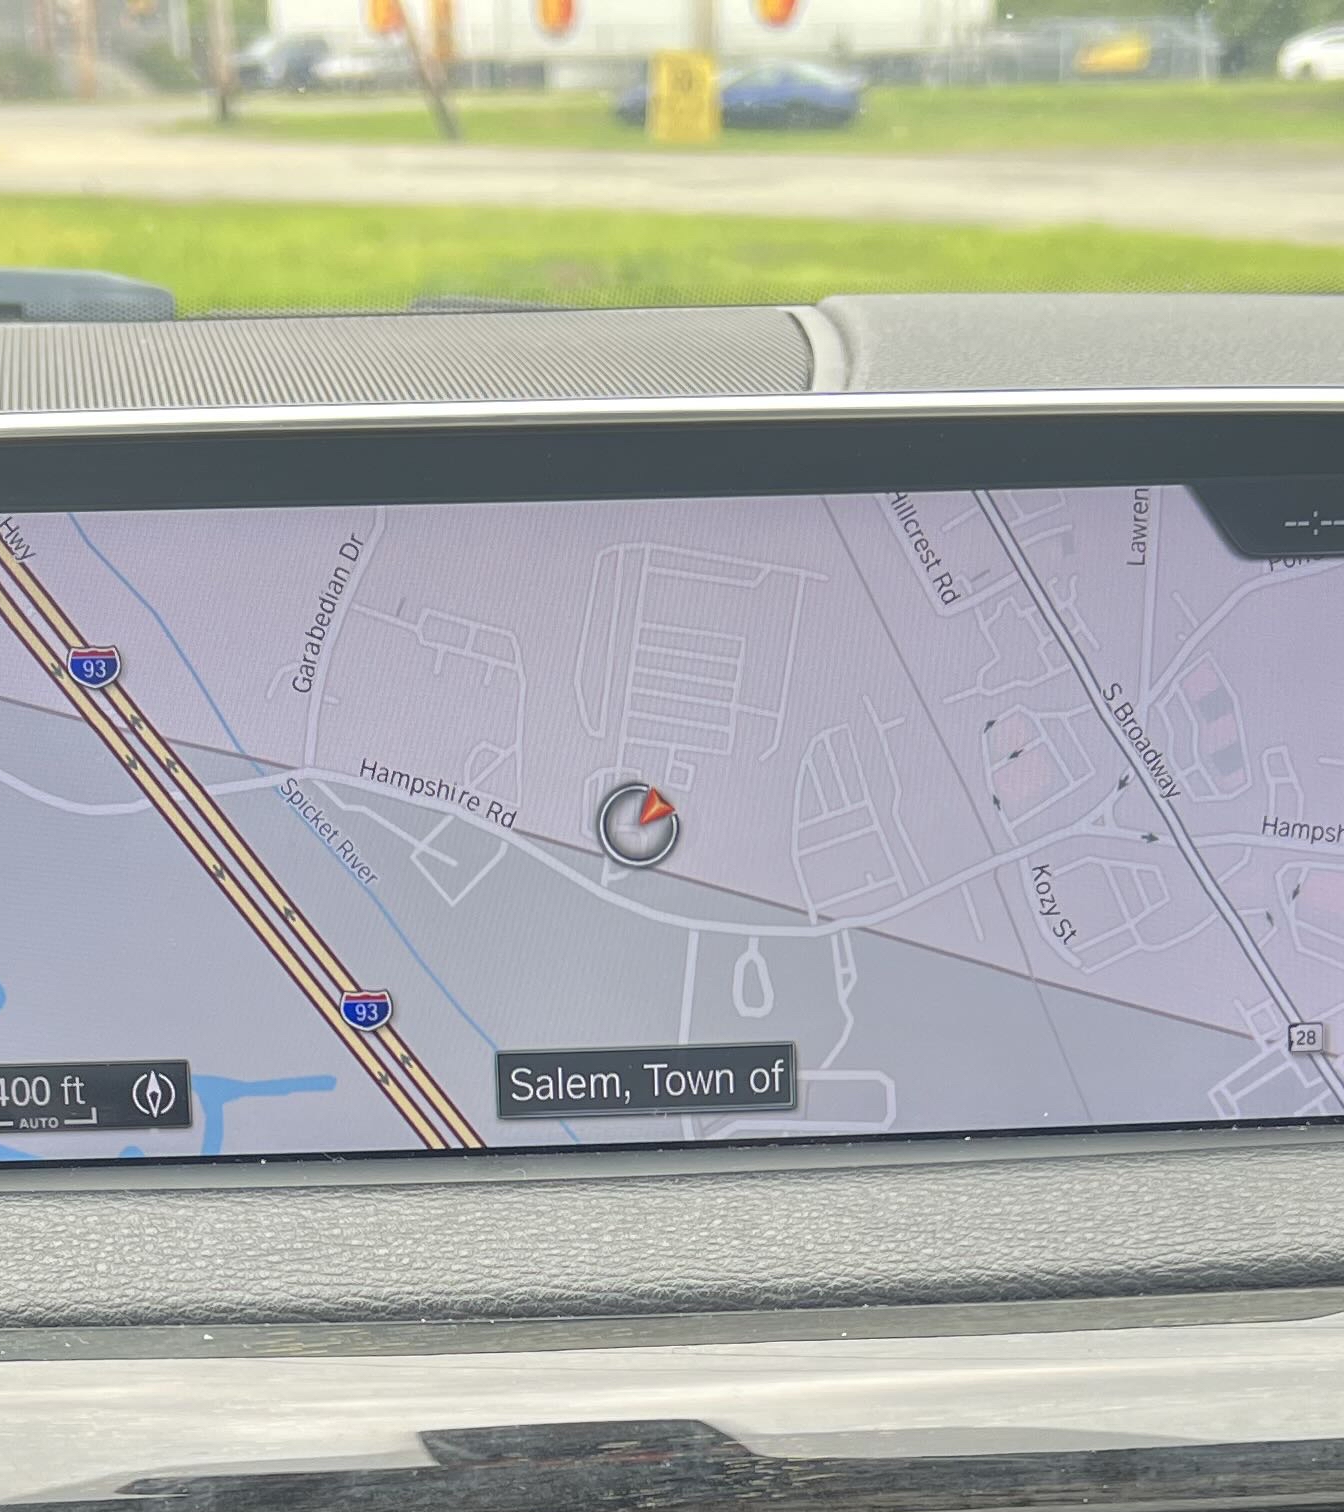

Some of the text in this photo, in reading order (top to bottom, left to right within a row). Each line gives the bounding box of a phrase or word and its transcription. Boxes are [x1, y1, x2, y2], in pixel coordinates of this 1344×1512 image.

[933, 572, 961, 605] Rd
[292, 533, 364, 692] Garabedian Dr
[83, 659, 107, 679] 93
[1102, 683, 1181, 799] S Broadway
[359, 758, 517, 828] Hampshire Rd
[280, 778, 379, 883] Spicket River
[1032, 864, 1076, 945] Kozy St
[355, 1004, 379, 1022] 93
[1296, 1030, 1316, 1045] 28
[61, 1075, 86, 1105] ft
[511, 1059, 785, 1104] Salem, Town of
[19, 1117, 59, 1129] AUTO
